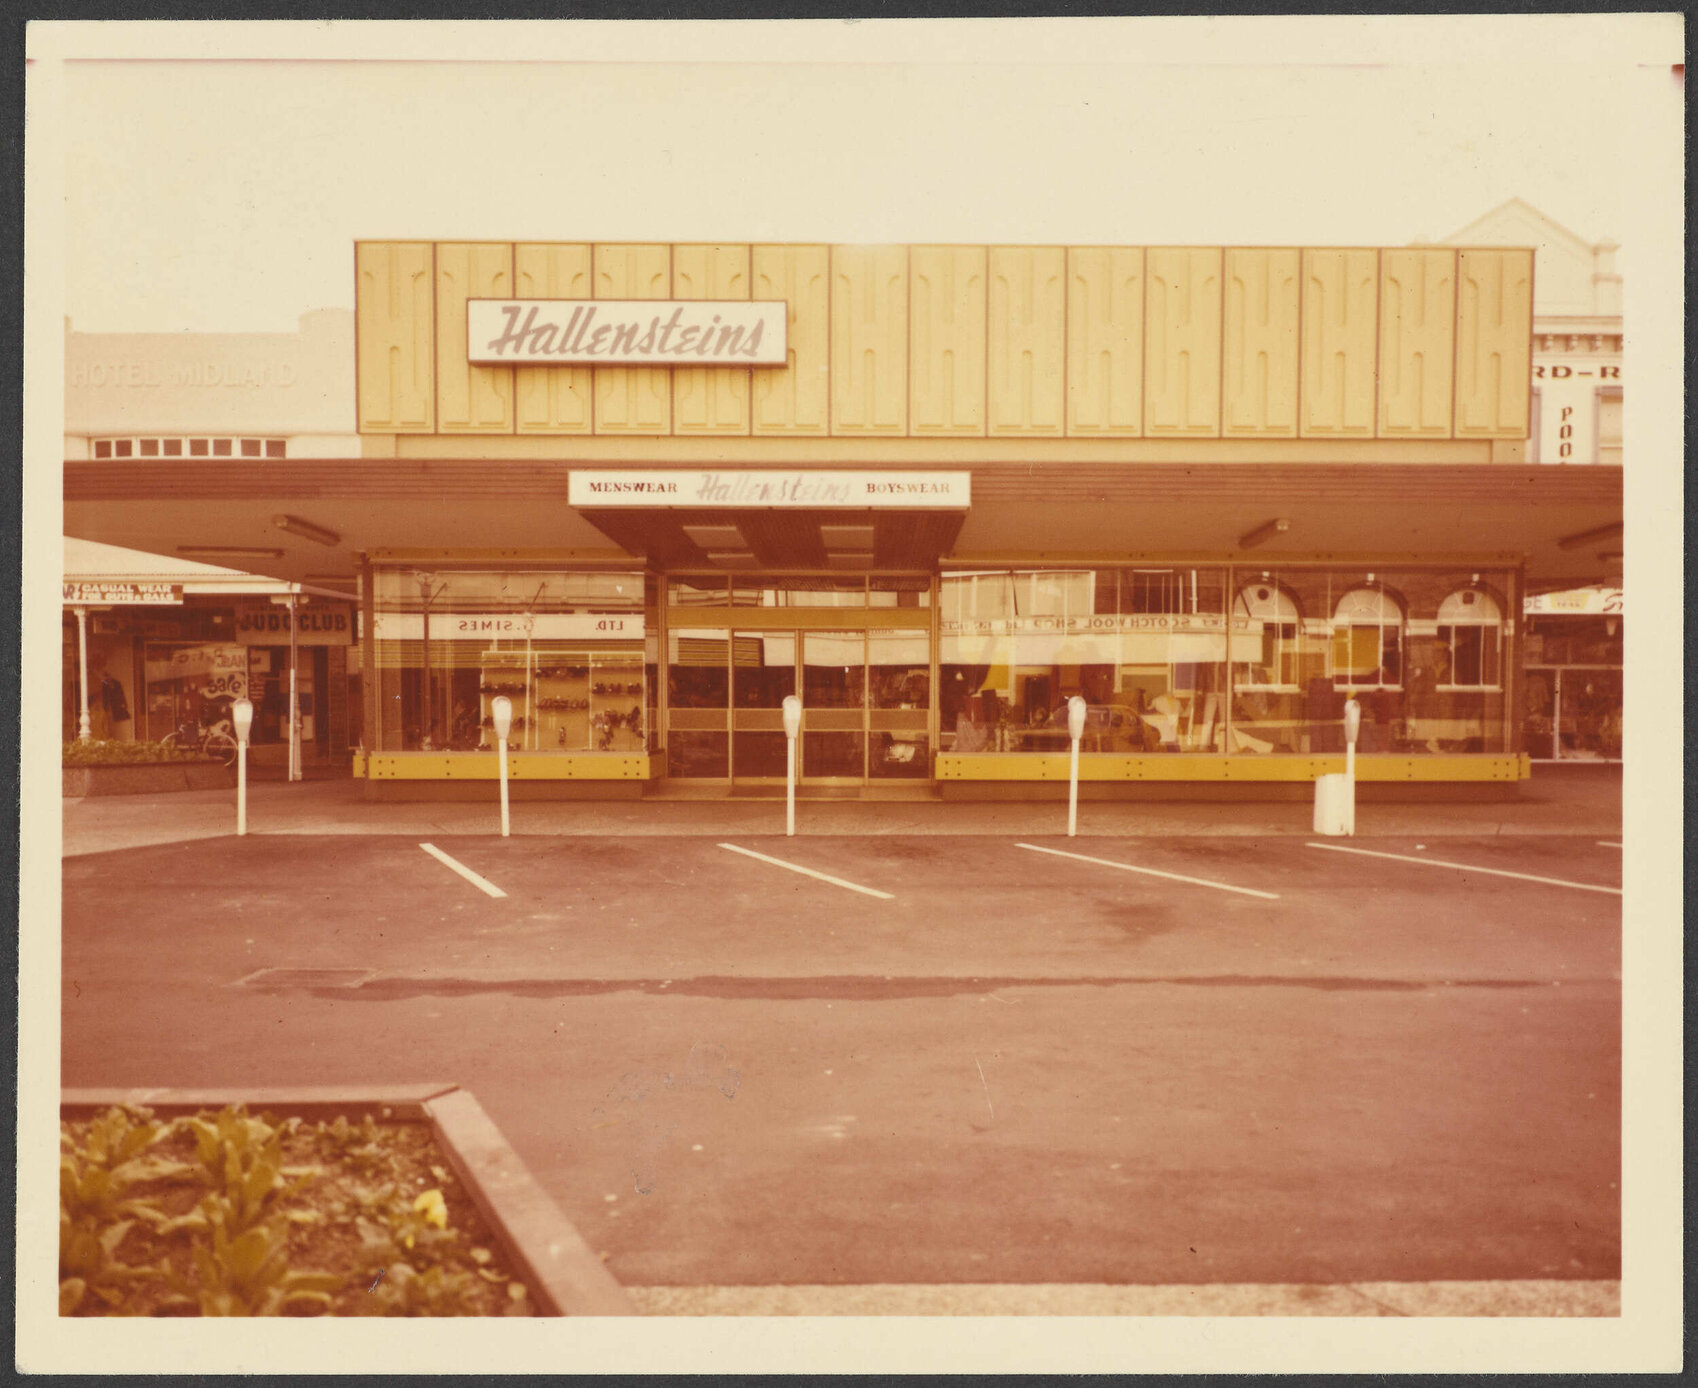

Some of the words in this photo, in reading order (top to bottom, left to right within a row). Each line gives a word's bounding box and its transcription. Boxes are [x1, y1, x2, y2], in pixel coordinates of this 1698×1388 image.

[487, 305, 765, 357] Hallensteins
[71, 363, 160, 388] HOTEL
[172, 362, 297, 389] MIDLAND
[1559, 406, 1573, 465] POO
[589, 481, 678, 493] MENSWEAR
[696, 473, 850, 503] Hallensteins
[866, 481, 951, 494] BOYSWEAR
[81, 584, 134, 593] CASUAL
[137, 584, 172, 593] WEAR
[240, 612, 291, 631] JUDO
[299, 612, 347, 631] CLUB
